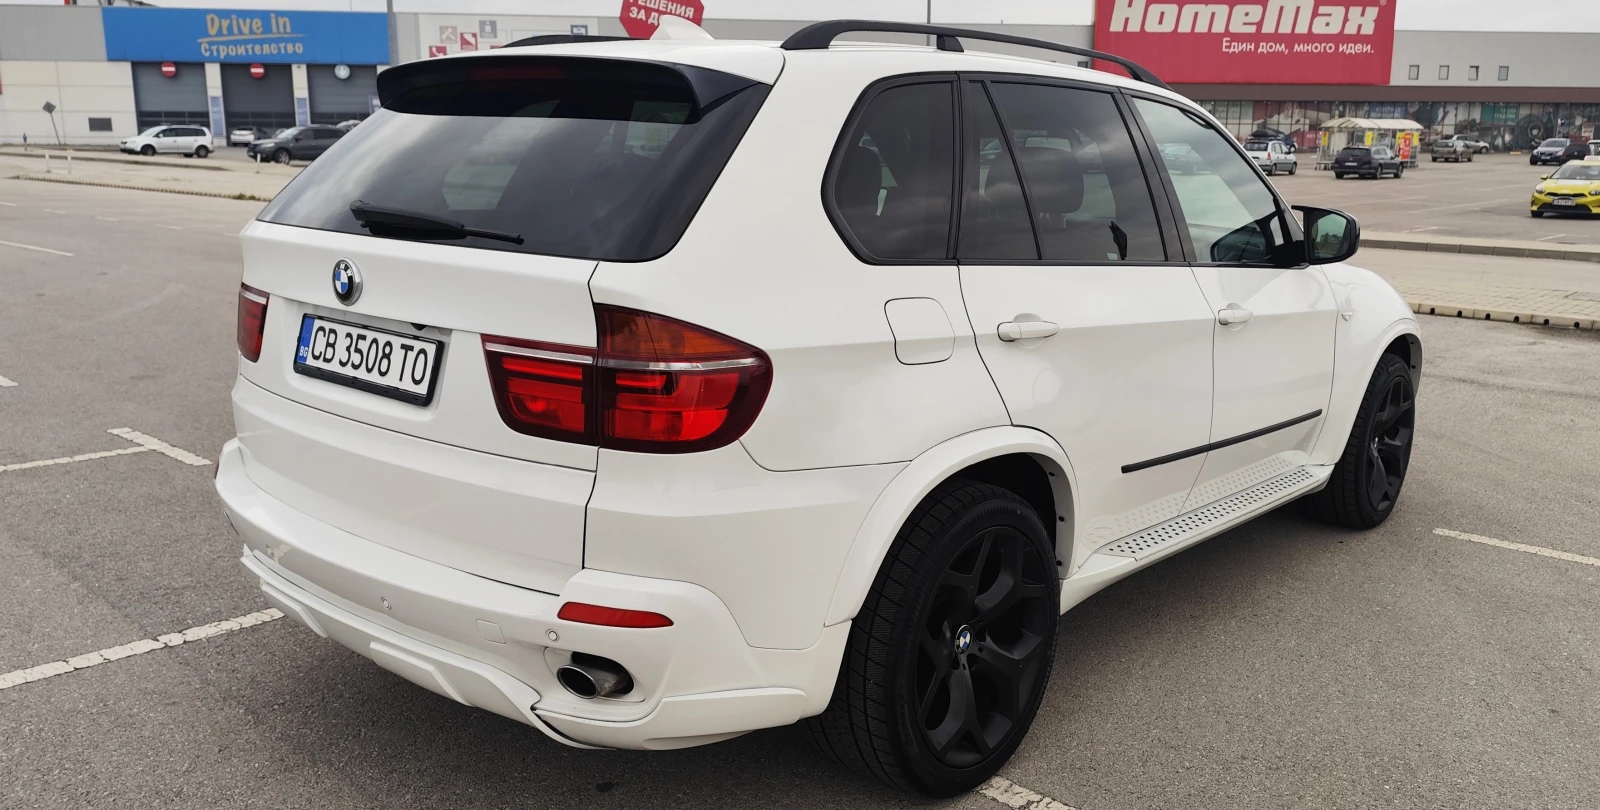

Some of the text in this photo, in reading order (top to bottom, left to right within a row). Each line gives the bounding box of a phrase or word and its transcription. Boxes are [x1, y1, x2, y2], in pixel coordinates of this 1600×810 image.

[629, 0, 694, 18] ЕШЕНИЯ
[629, 6, 646, 21] ЗА
[1109, 0, 1379, 35] HomeMax
[206, 12, 291, 36] Drive in
[200, 41, 304, 59] Строителство
[1222, 37, 1375, 55] Един дом, много идеи.
[299, 346, 309, 358] BG
[311, 326, 428, 385] CB 3508 TO
